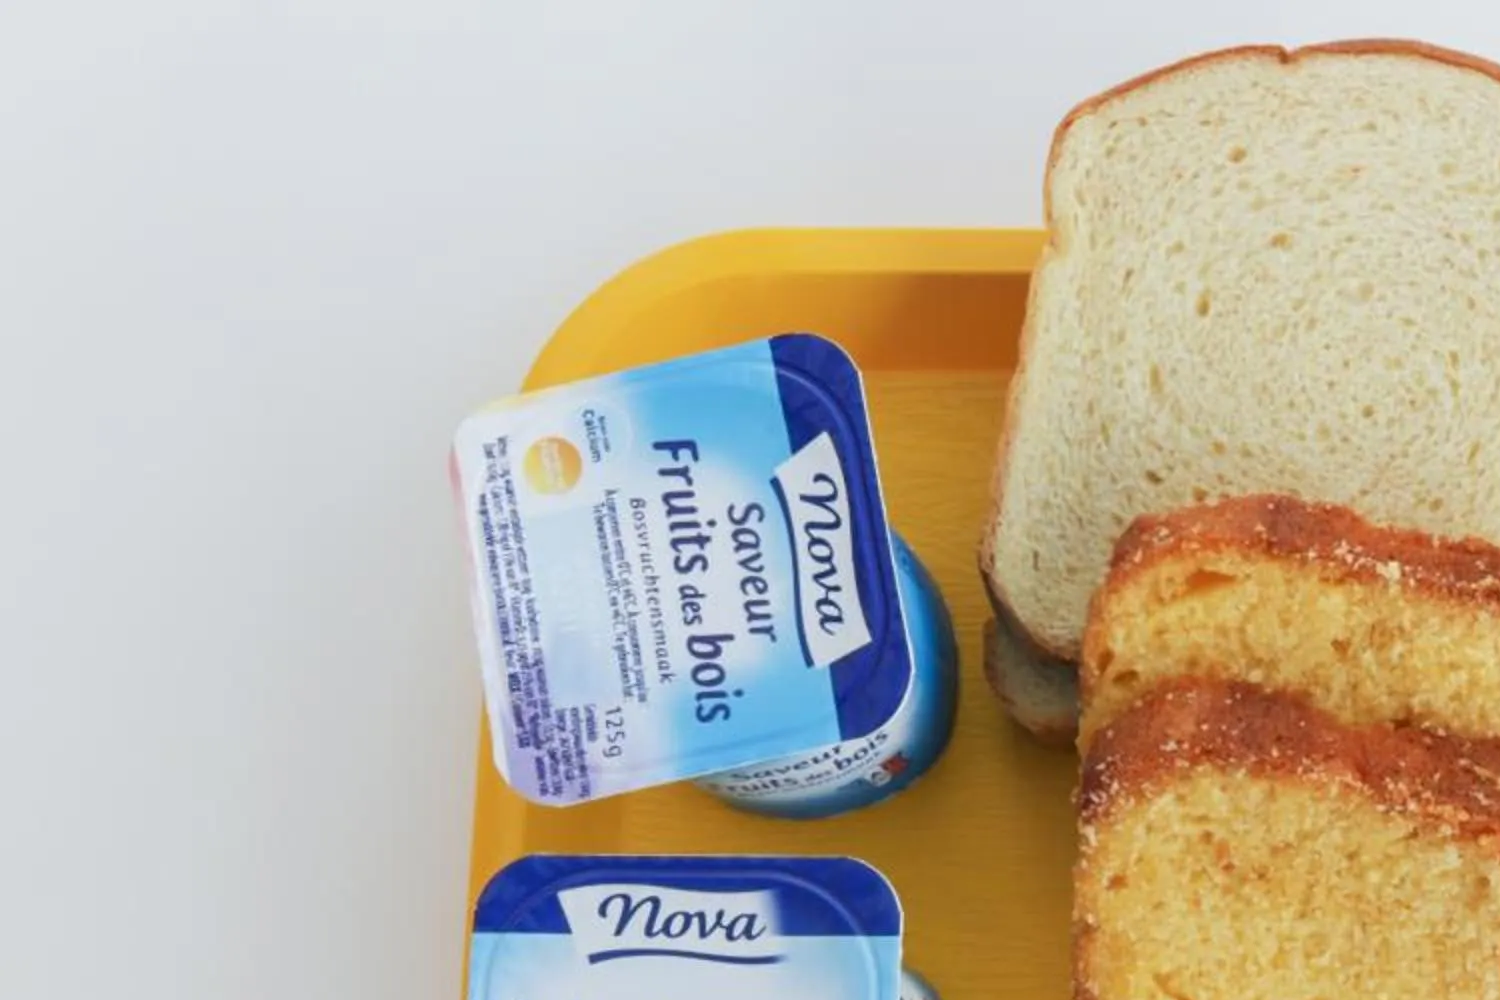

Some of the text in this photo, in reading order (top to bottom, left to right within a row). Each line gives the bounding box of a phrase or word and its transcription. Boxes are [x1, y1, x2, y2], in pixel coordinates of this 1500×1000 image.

[630, 497, 677, 684] Bosvruchtensmaak
[653, 438, 746, 725] Fruits des bois
[728, 502, 776, 643] Saveur
[800, 472, 847, 636] Nova
[601, 706, 627, 758] 125g
[833, 731, 888, 771] bois
[597, 893, 766, 942] Nova
